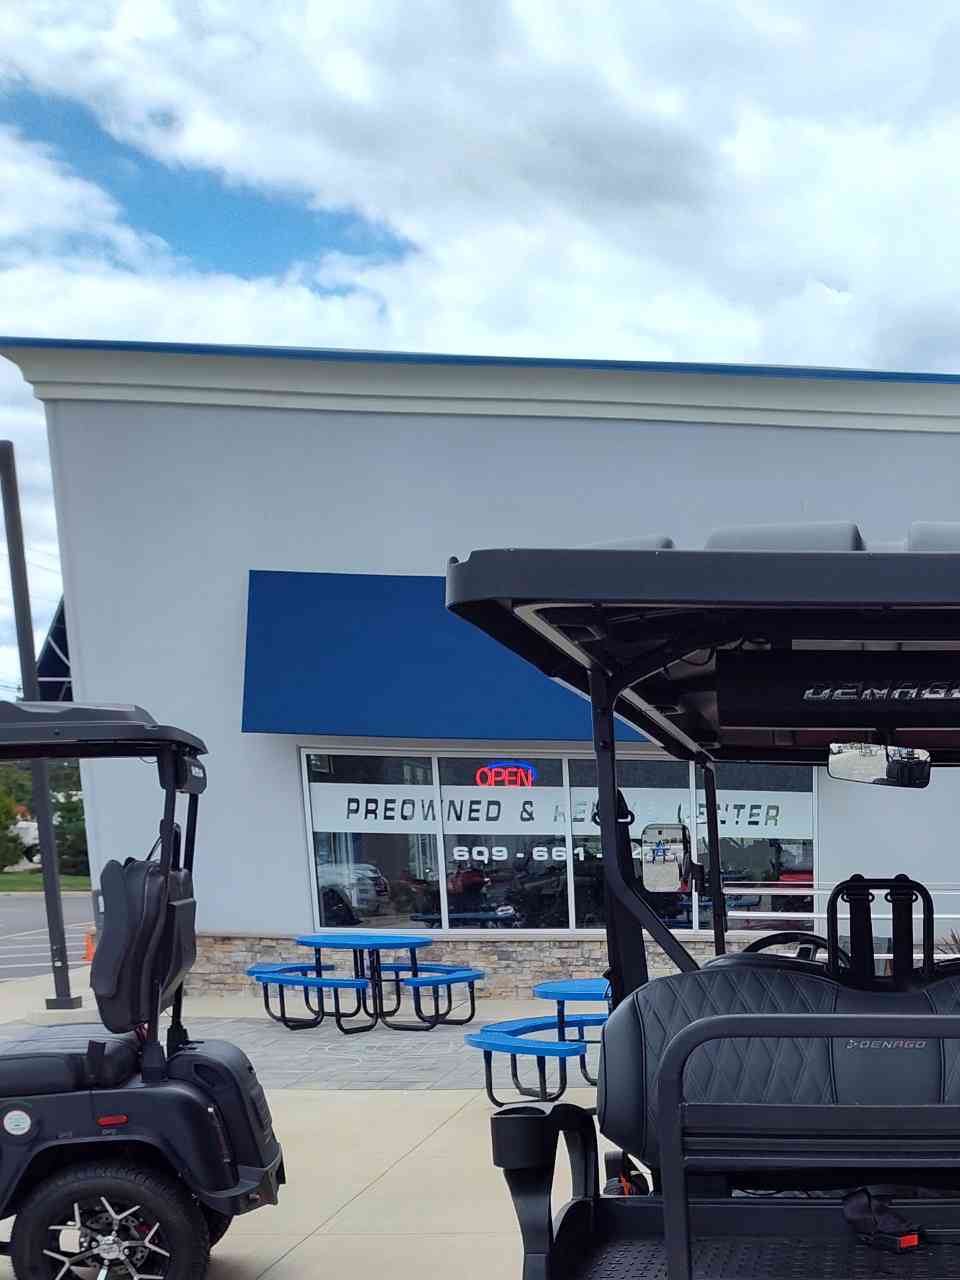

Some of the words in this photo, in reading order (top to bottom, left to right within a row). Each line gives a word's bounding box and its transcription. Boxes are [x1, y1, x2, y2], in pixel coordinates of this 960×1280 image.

[475, 767, 534, 787] OPEN
[346, 797, 502, 822] PREOWNED
[519, 800, 535, 822] &
[860, 1039, 927, 1049] DENAGO
